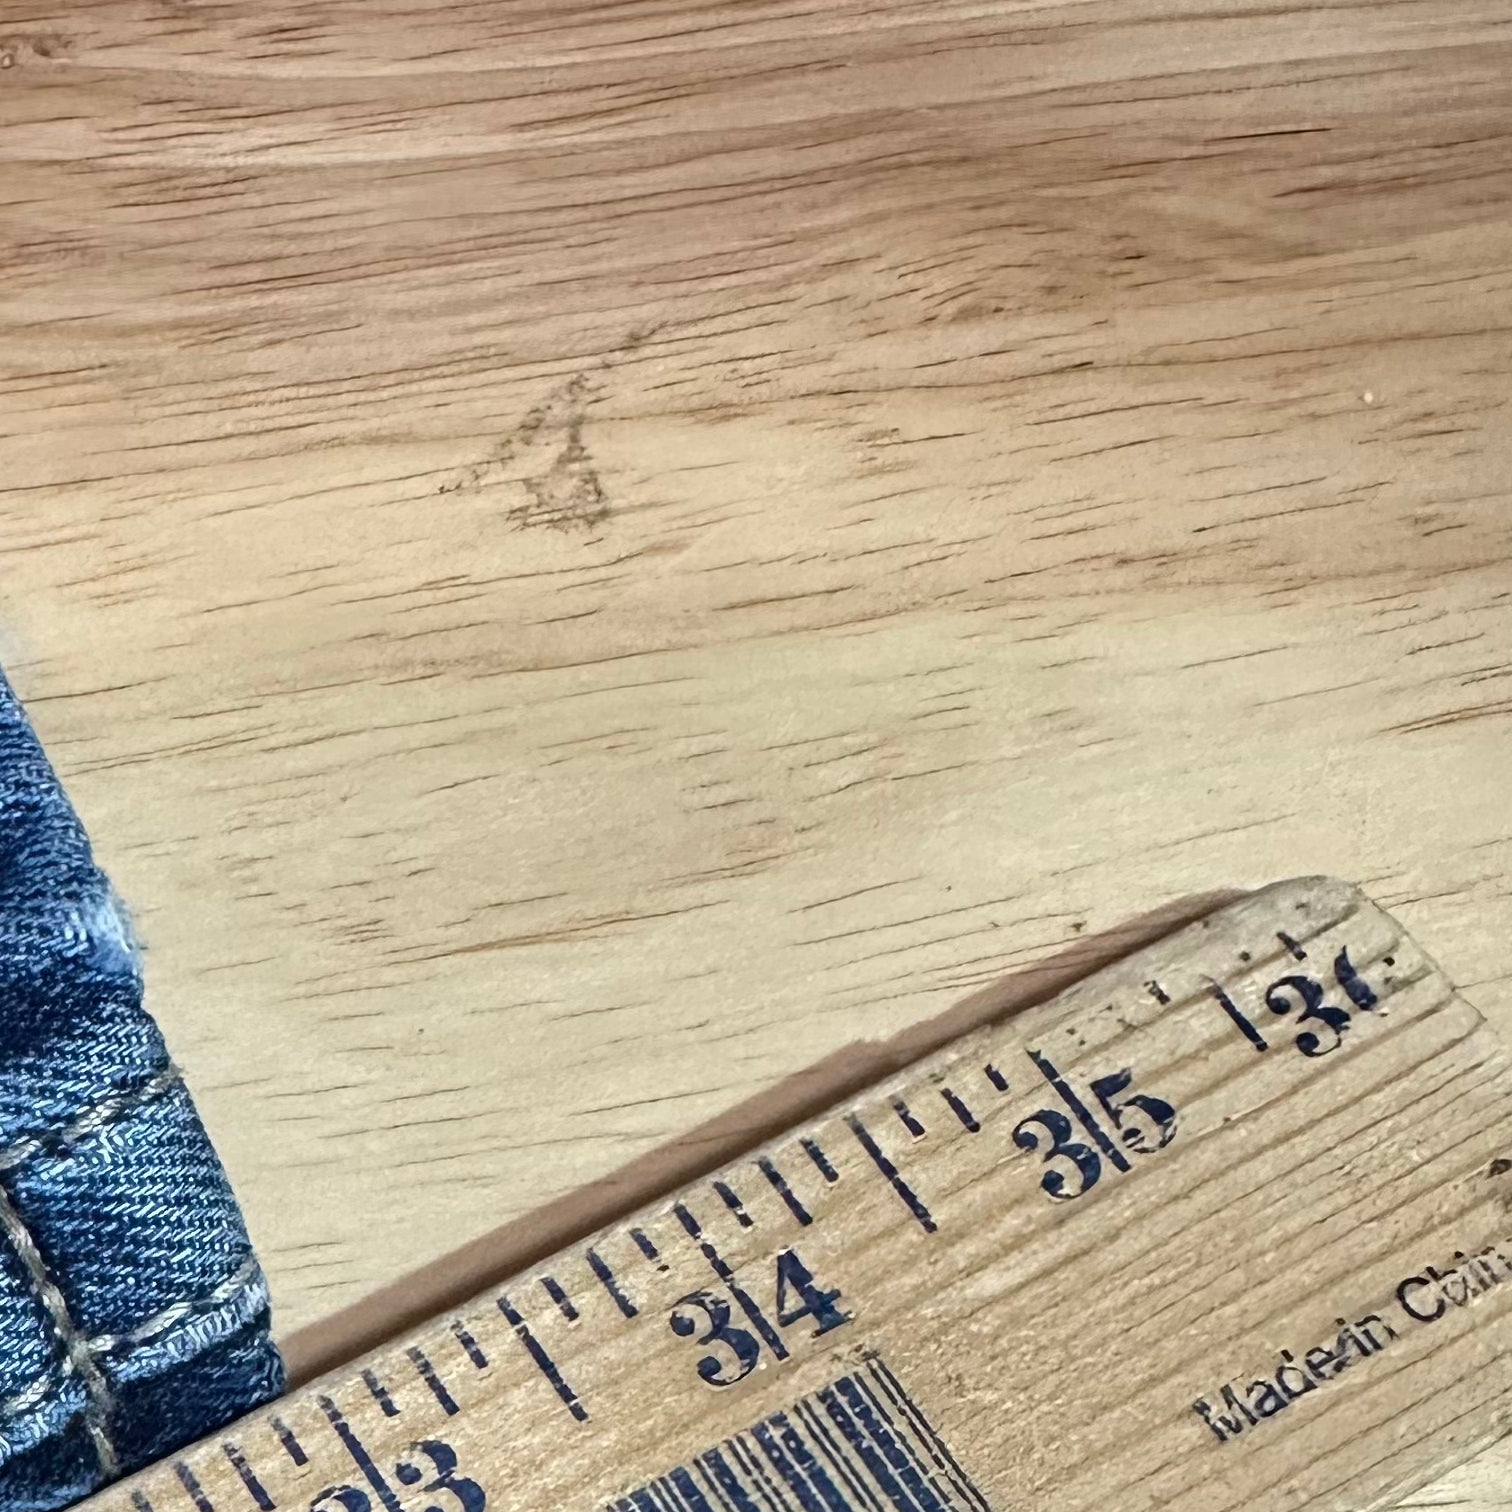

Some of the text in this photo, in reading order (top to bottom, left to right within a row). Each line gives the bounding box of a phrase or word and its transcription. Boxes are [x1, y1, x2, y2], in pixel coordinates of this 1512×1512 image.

[1010, 1067, 1178, 1200] 35
[669, 1247, 856, 1389] 34
[1192, 1347, 1340, 1442] Made
